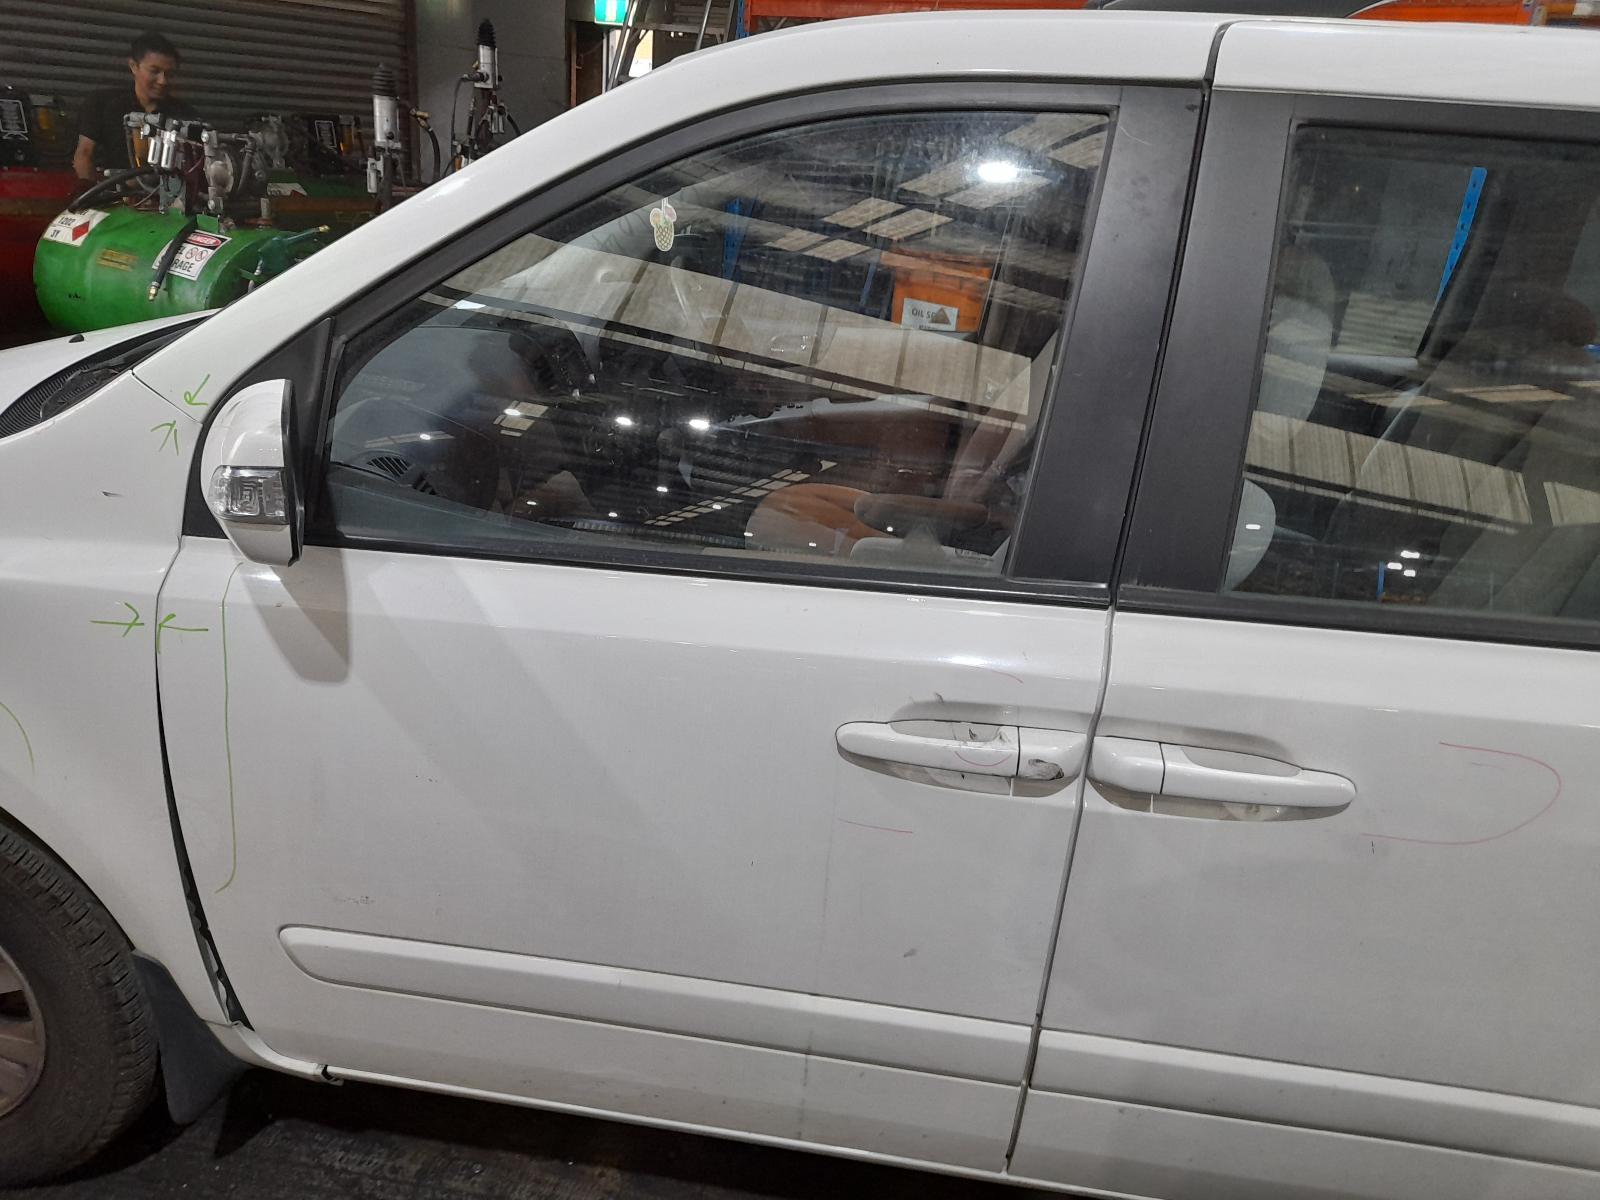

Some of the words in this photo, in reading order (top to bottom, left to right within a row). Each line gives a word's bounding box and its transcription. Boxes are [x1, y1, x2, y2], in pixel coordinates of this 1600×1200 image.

[58, 217, 76, 226] 1202
[50, 229, 61, 238] 3Y
[911, 306, 924, 318] OIL
